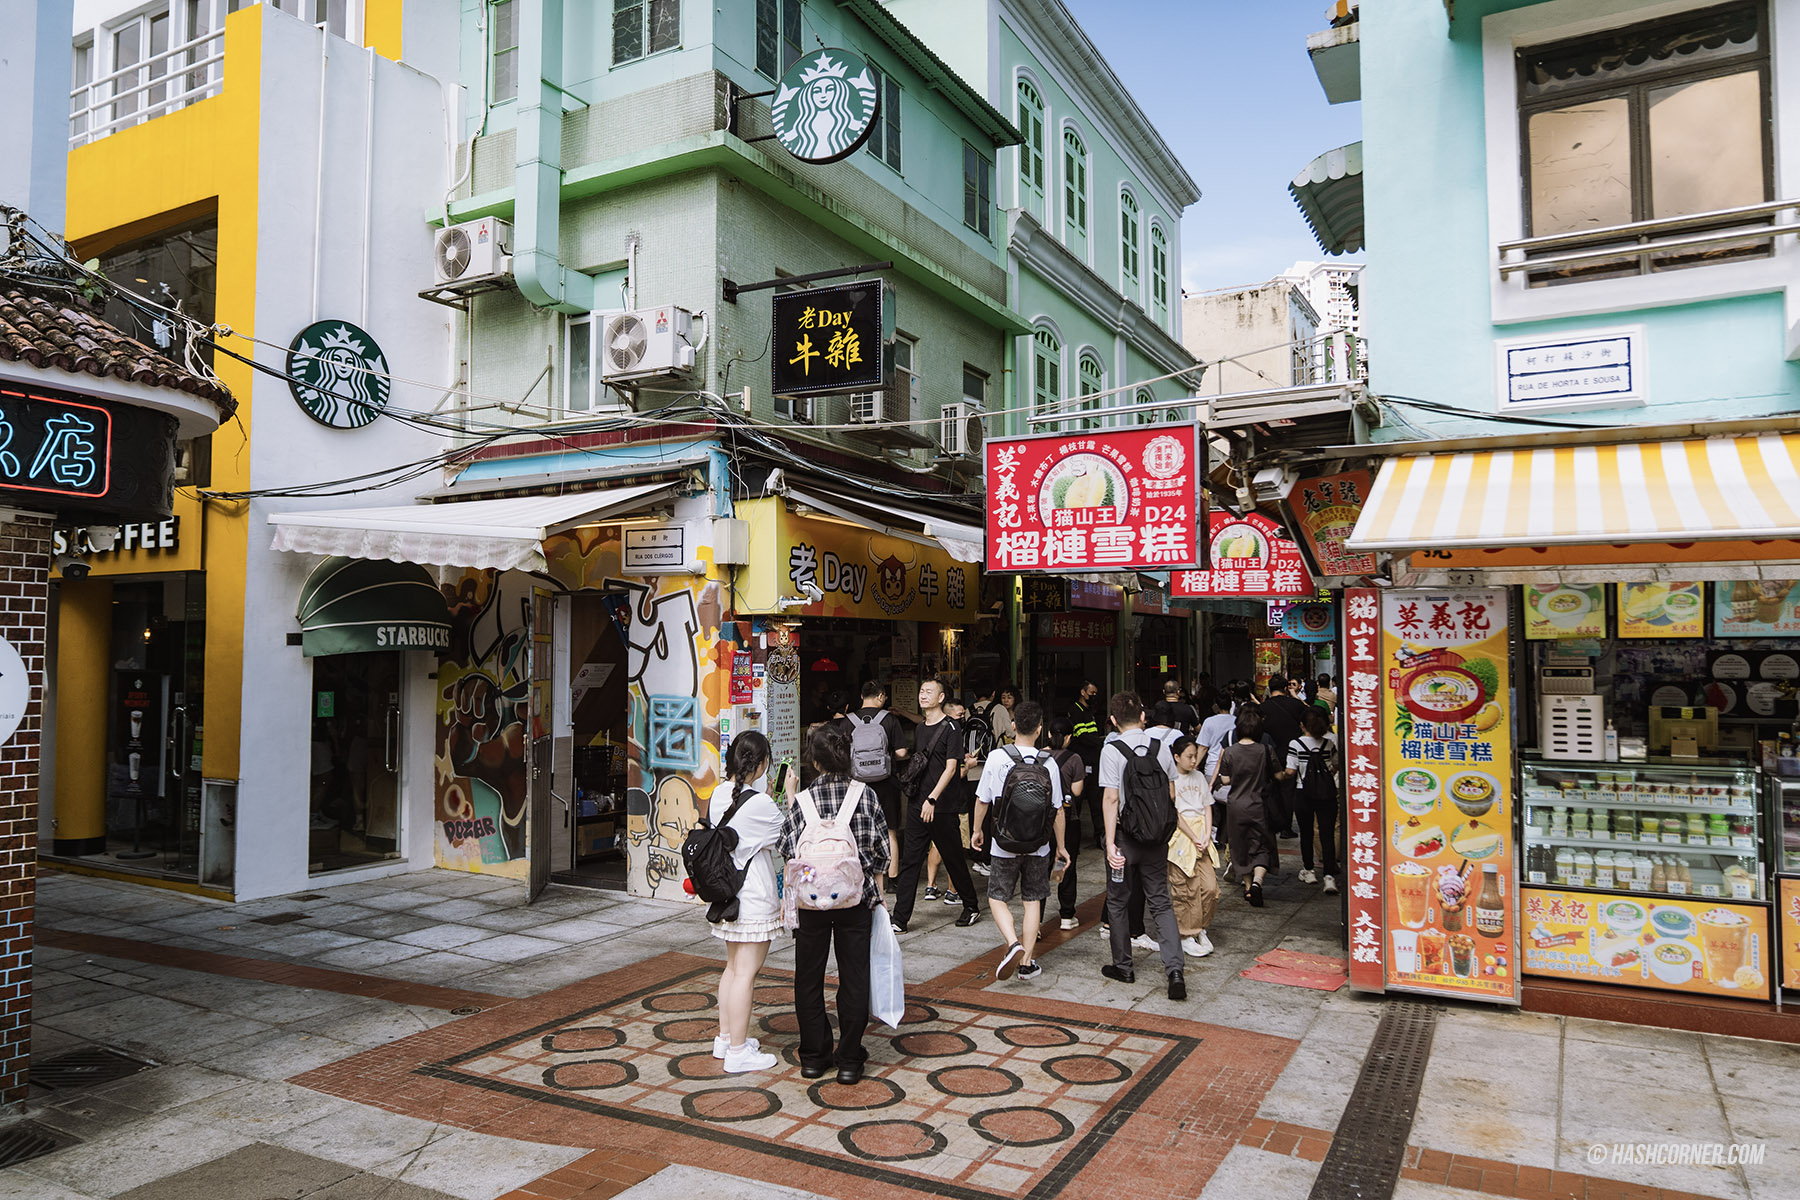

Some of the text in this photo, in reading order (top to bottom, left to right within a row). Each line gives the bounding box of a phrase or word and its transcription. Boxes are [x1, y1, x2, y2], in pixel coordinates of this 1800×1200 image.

[797, 306, 853, 331] 老Day
[788, 328, 864, 377] 牛雜
[1517, 383, 1534, 391] RUA
[1552, 379, 1580, 388] HORTA
[1592, 375, 1621, 384] SOUSA
[0, 409, 97, 488] 店
[993, 446, 1023, 529] 莫義記
[1054, 507, 1115, 527] 猫山王
[1145, 505, 1187, 523] D24
[995, 523, 1189, 568] 榴槤雪糕
[789, 542, 966, 609] 老Day 牛雜
[1220, 558, 1260, 570] 猫山王
[1277, 559, 1302, 570] D24
[1180, 569, 1303, 593] 榴槤雪糕
[1467, 574, 1475, 585] 3
[1394, 601, 1491, 631] 莫義記
[377, 625, 449, 647] STARBUCKS
[1347, 595, 1378, 662] 貓山王
[1402, 630, 1488, 640] Mok Yei Kei
[1413, 723, 1479, 741] 猫山王
[1400, 740, 1494, 762] 榴槤雪糕
[858, 759, 882, 768] SKECHERS
[443, 816, 496, 846] DOZAR
[1526, 897, 1589, 920] 莫義記
[1351, 909, 1382, 965] 大菜糕
